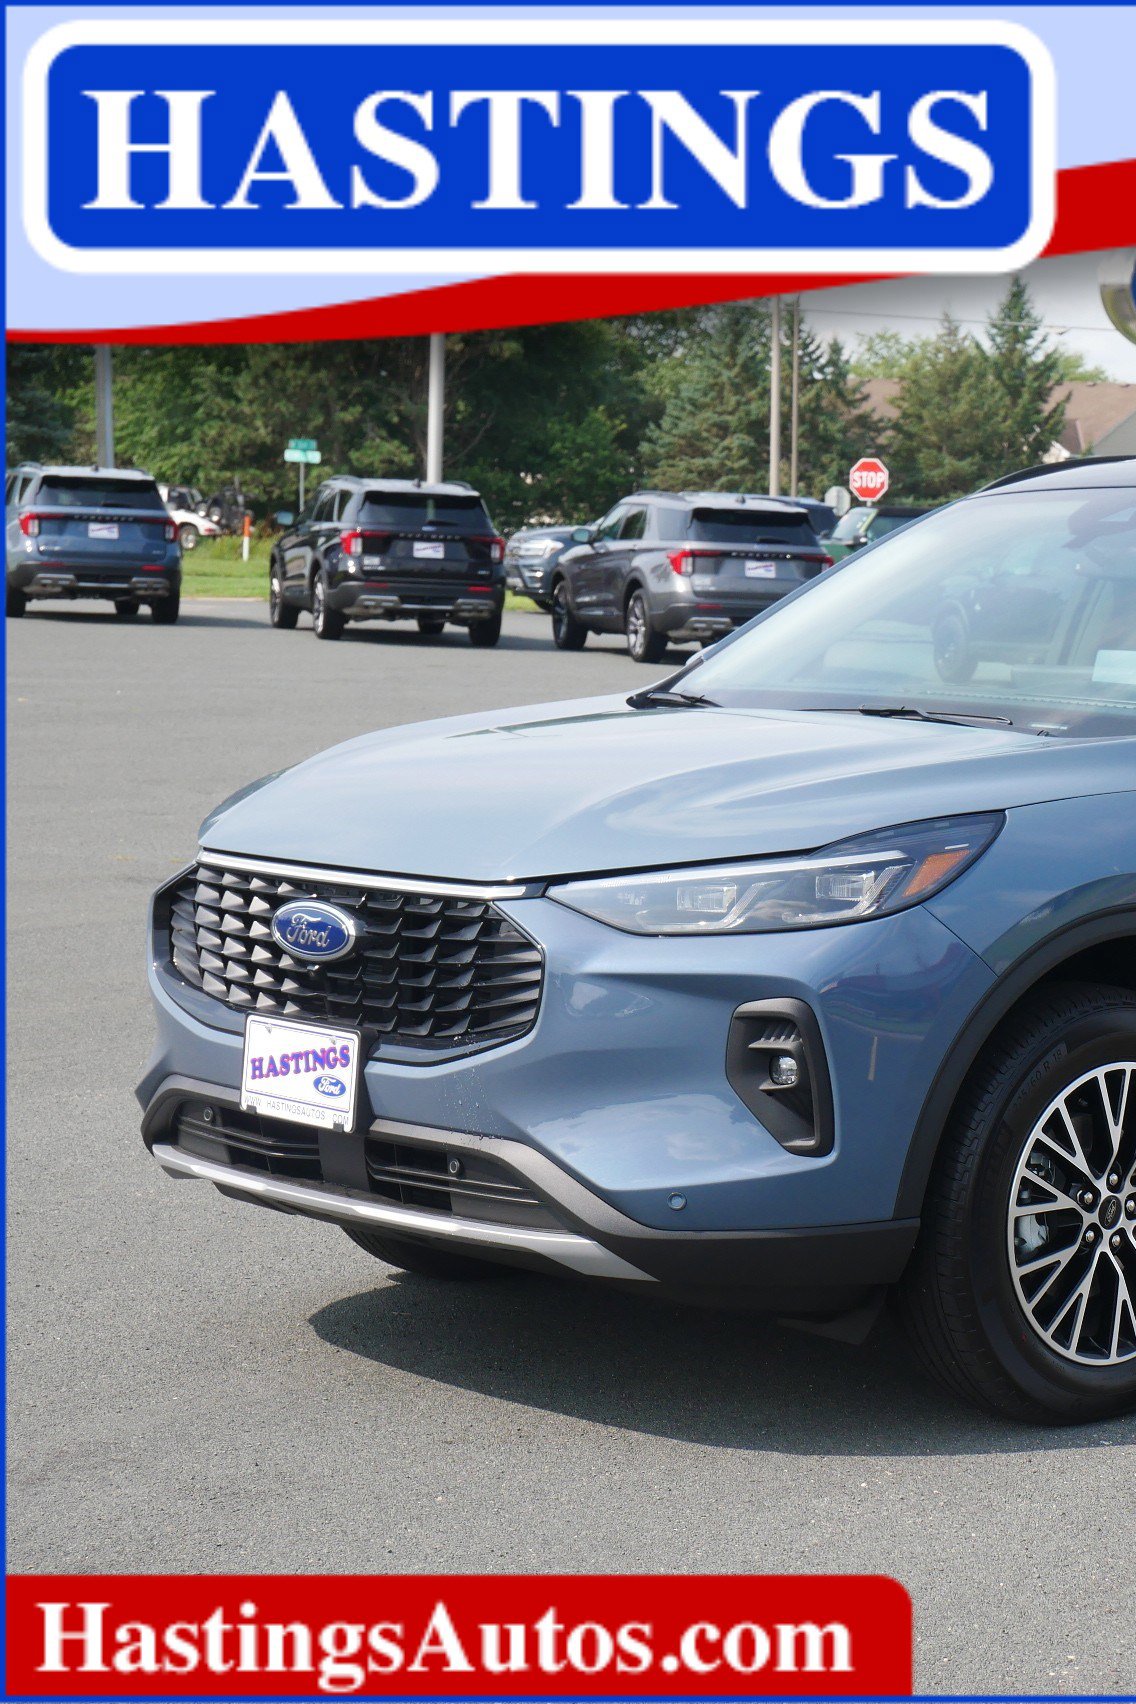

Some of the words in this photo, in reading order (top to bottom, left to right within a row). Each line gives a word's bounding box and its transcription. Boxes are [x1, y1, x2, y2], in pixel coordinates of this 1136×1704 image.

[852, 471, 885, 489] STOP
[285, 912, 332, 948] Ford
[250, 1044, 351, 1080] HASTINGS
[317, 1076, 341, 1096] Ford
